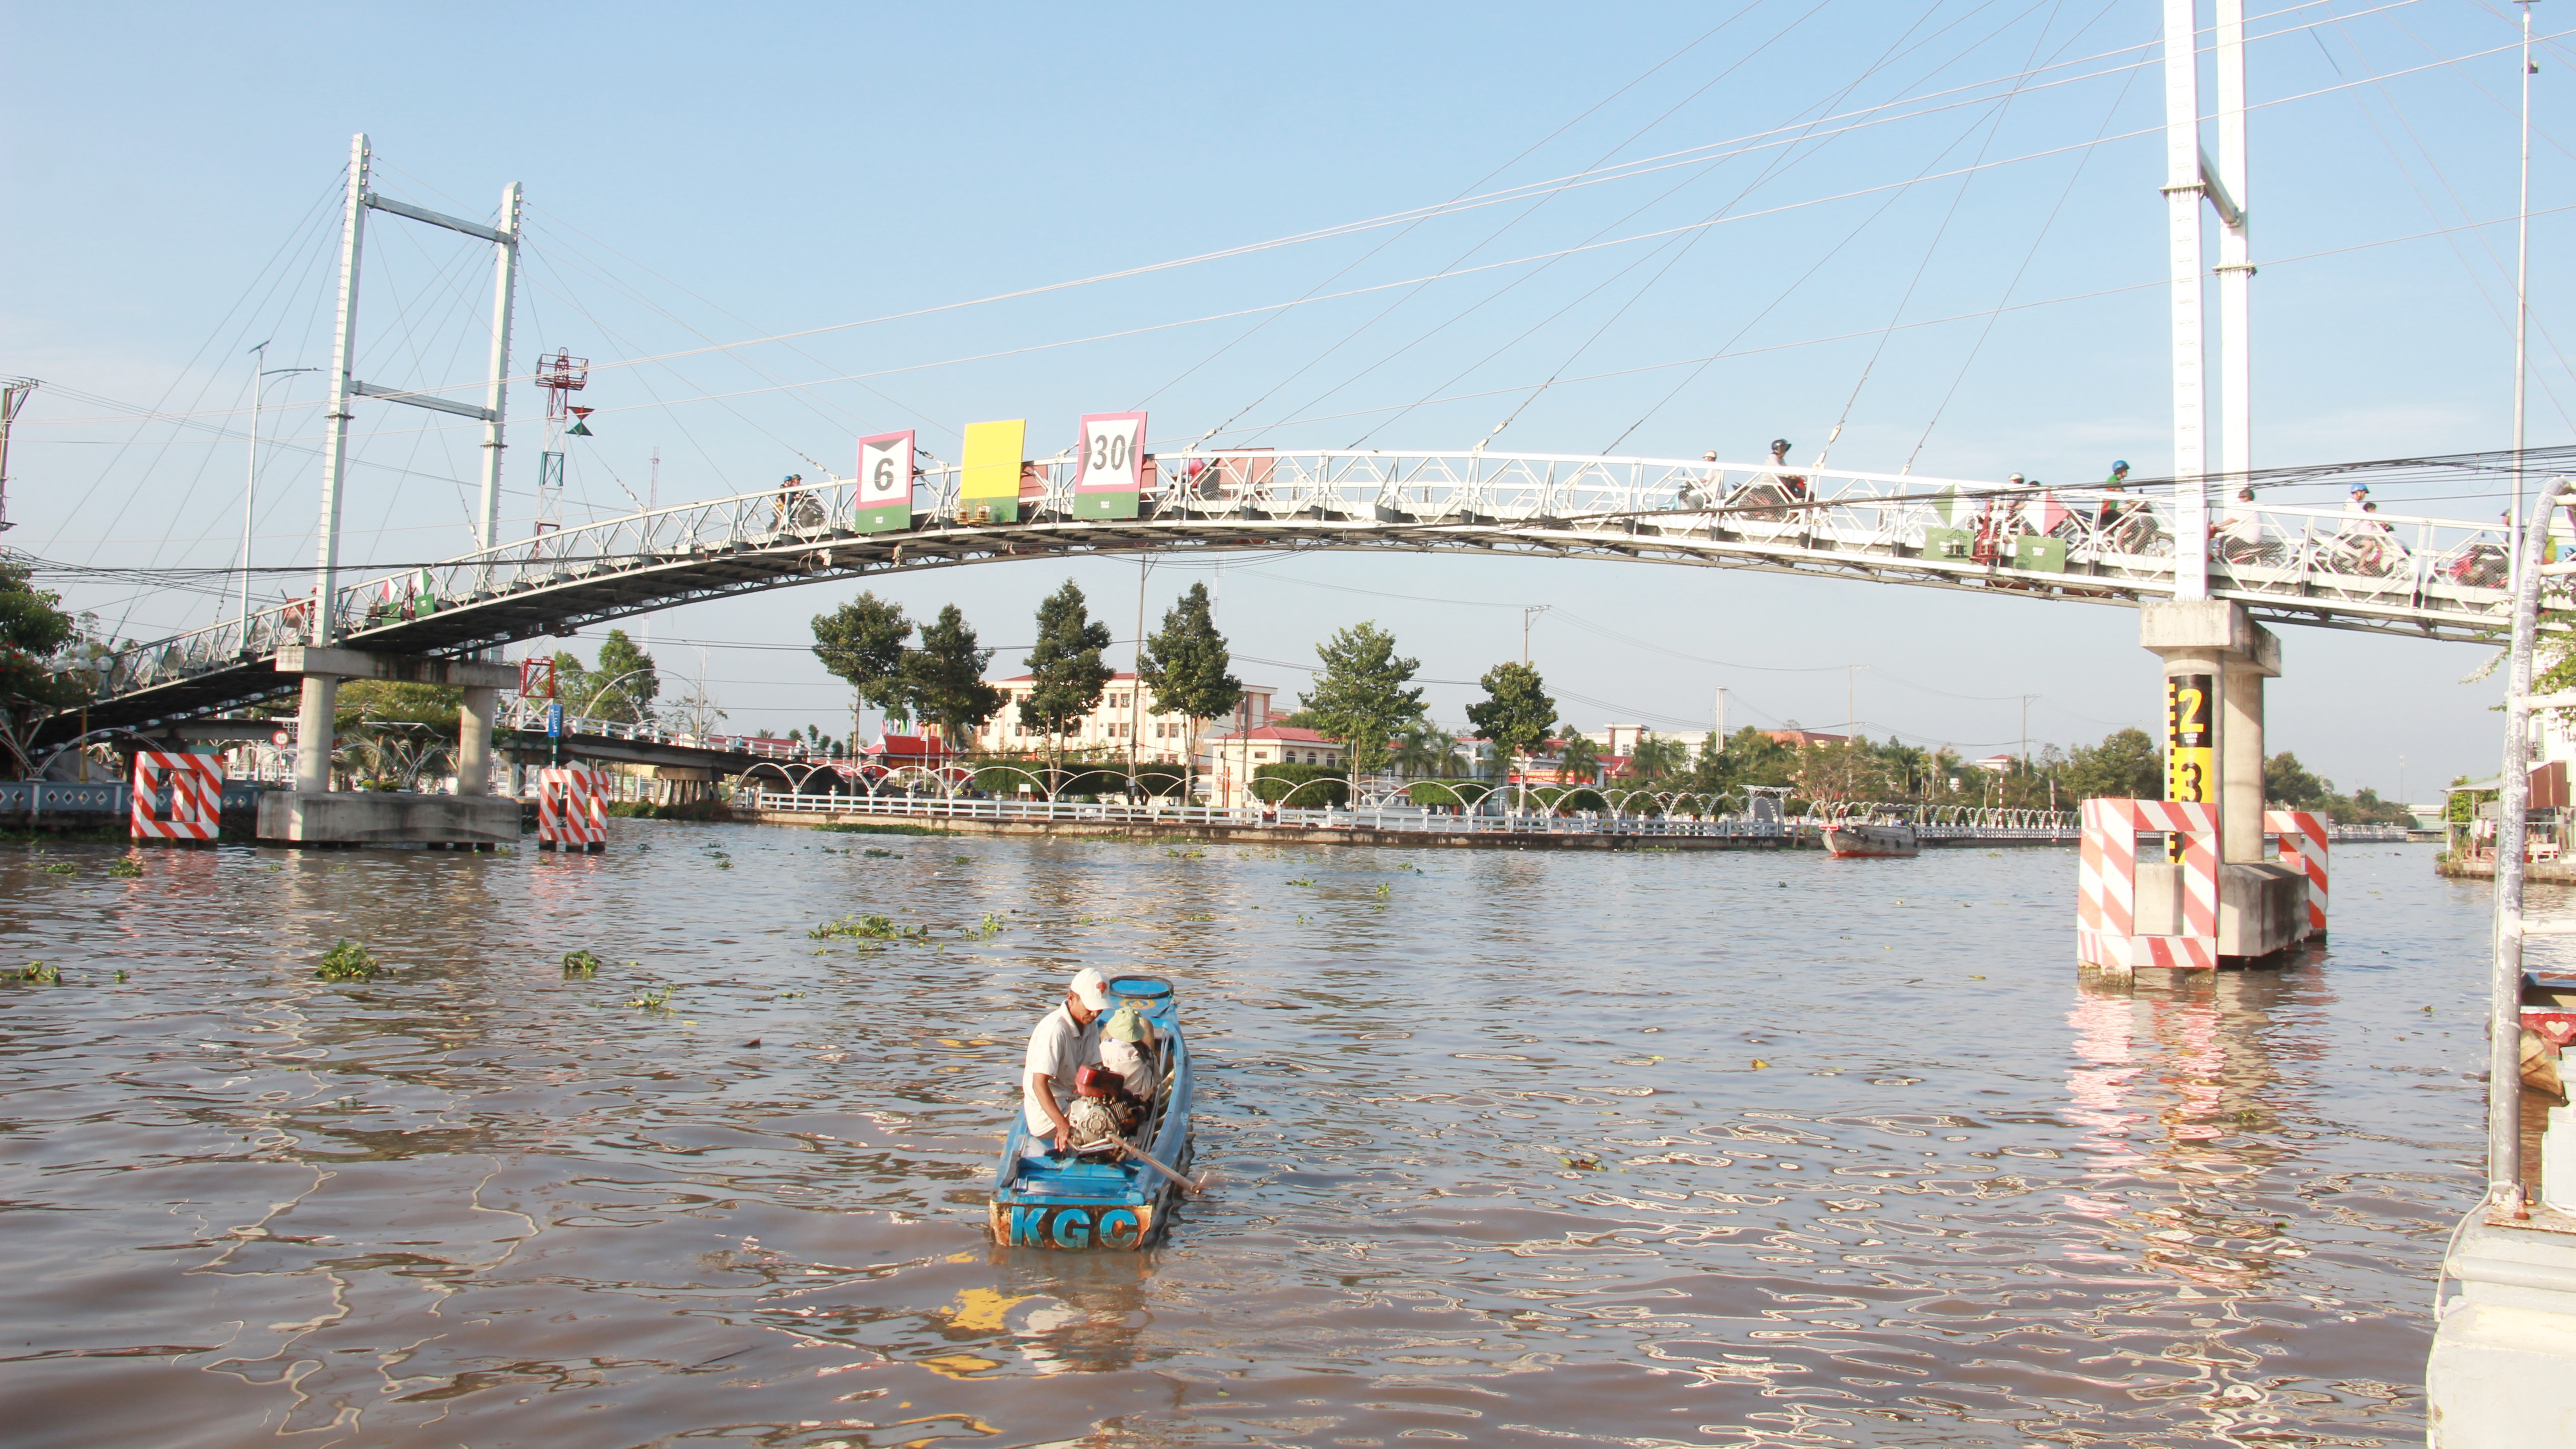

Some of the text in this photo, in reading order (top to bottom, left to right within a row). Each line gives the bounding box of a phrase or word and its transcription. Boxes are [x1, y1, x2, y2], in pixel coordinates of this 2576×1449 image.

[1093, 435, 1125, 470] 30
[874, 457, 894, 491] 6
[2178, 688, 2205, 733] 2
[2181, 762, 2203, 803] 3
[1009, 1205, 1138, 1249] KGC
